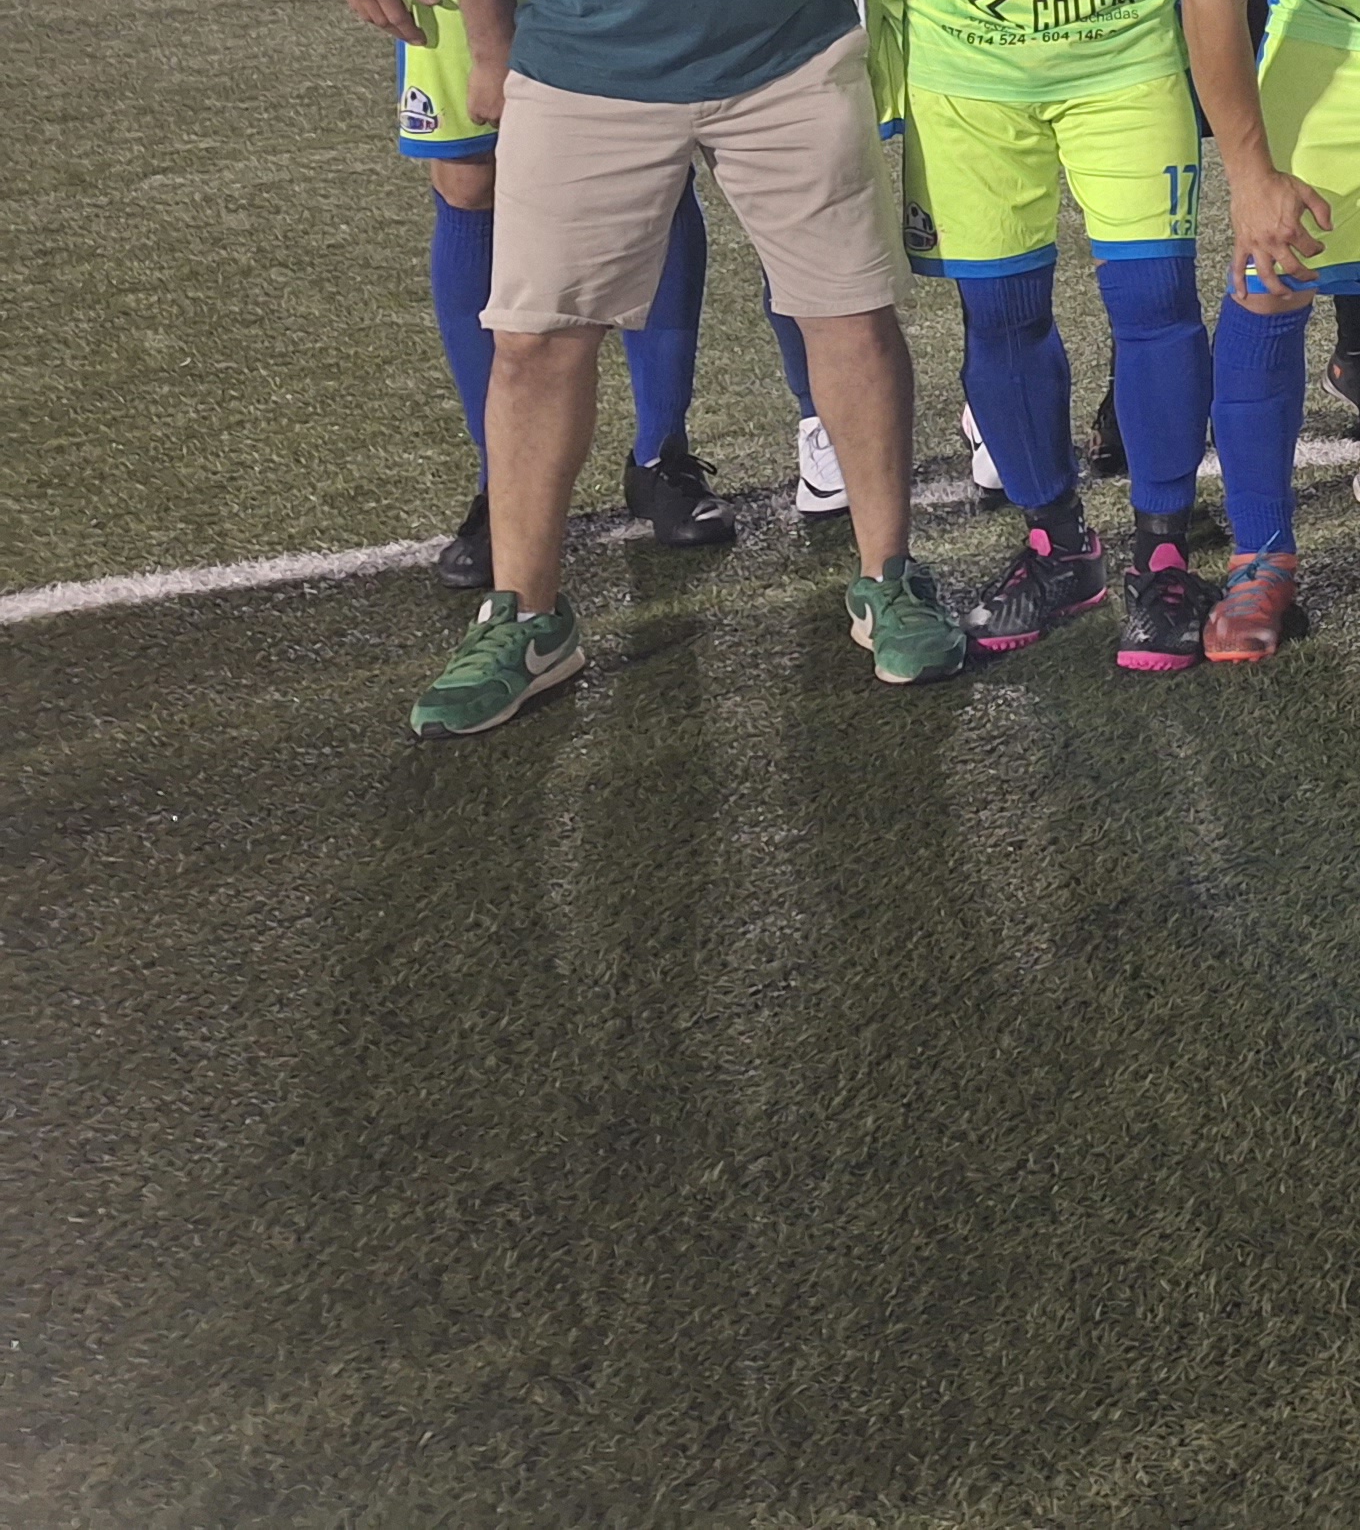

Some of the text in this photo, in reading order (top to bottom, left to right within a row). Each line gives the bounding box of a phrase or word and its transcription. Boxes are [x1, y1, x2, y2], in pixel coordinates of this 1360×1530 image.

[967, 32, 994, 45] 614
[999, 33, 1026, 45] 524
[1042, 31, 1069, 43] 604
[1163, 164, 1196, 216] 17
